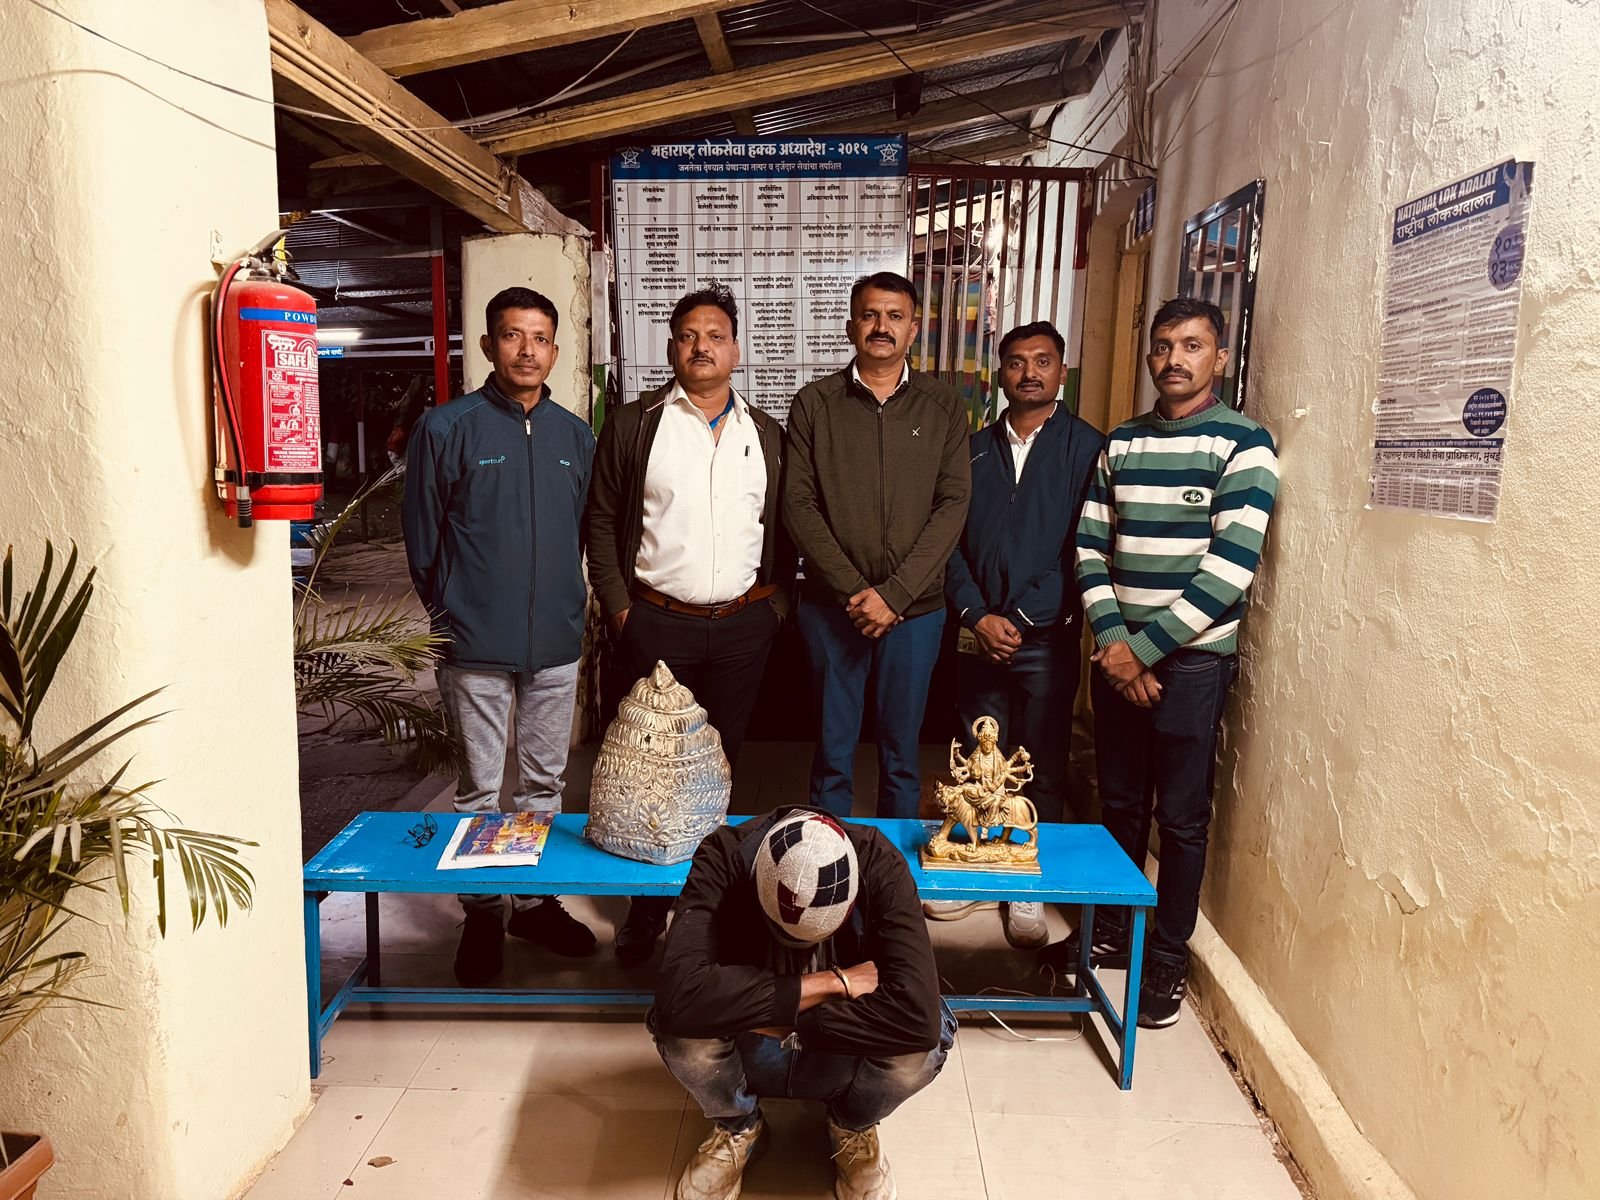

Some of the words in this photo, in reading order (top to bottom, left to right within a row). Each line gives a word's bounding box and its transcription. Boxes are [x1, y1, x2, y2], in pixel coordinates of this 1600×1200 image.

[650, 144, 695, 160] महाराष्ट्र
[698, 139, 745, 156] लोकसेवा
[748, 143, 776, 158] हक्क
[779, 138, 826, 157] अध्यादेश
[838, 142, 868, 155] २०१५
[1398, 193, 1437, 222] NATIONAL
[1438, 184, 1458, 206] LOK
[1458, 168, 1498, 198] ADALAT
[1396, 217, 1425, 238] राष्ट्रीय
[279, 353, 306, 367] SAFE
[1184, 493, 1202, 501] FILA
